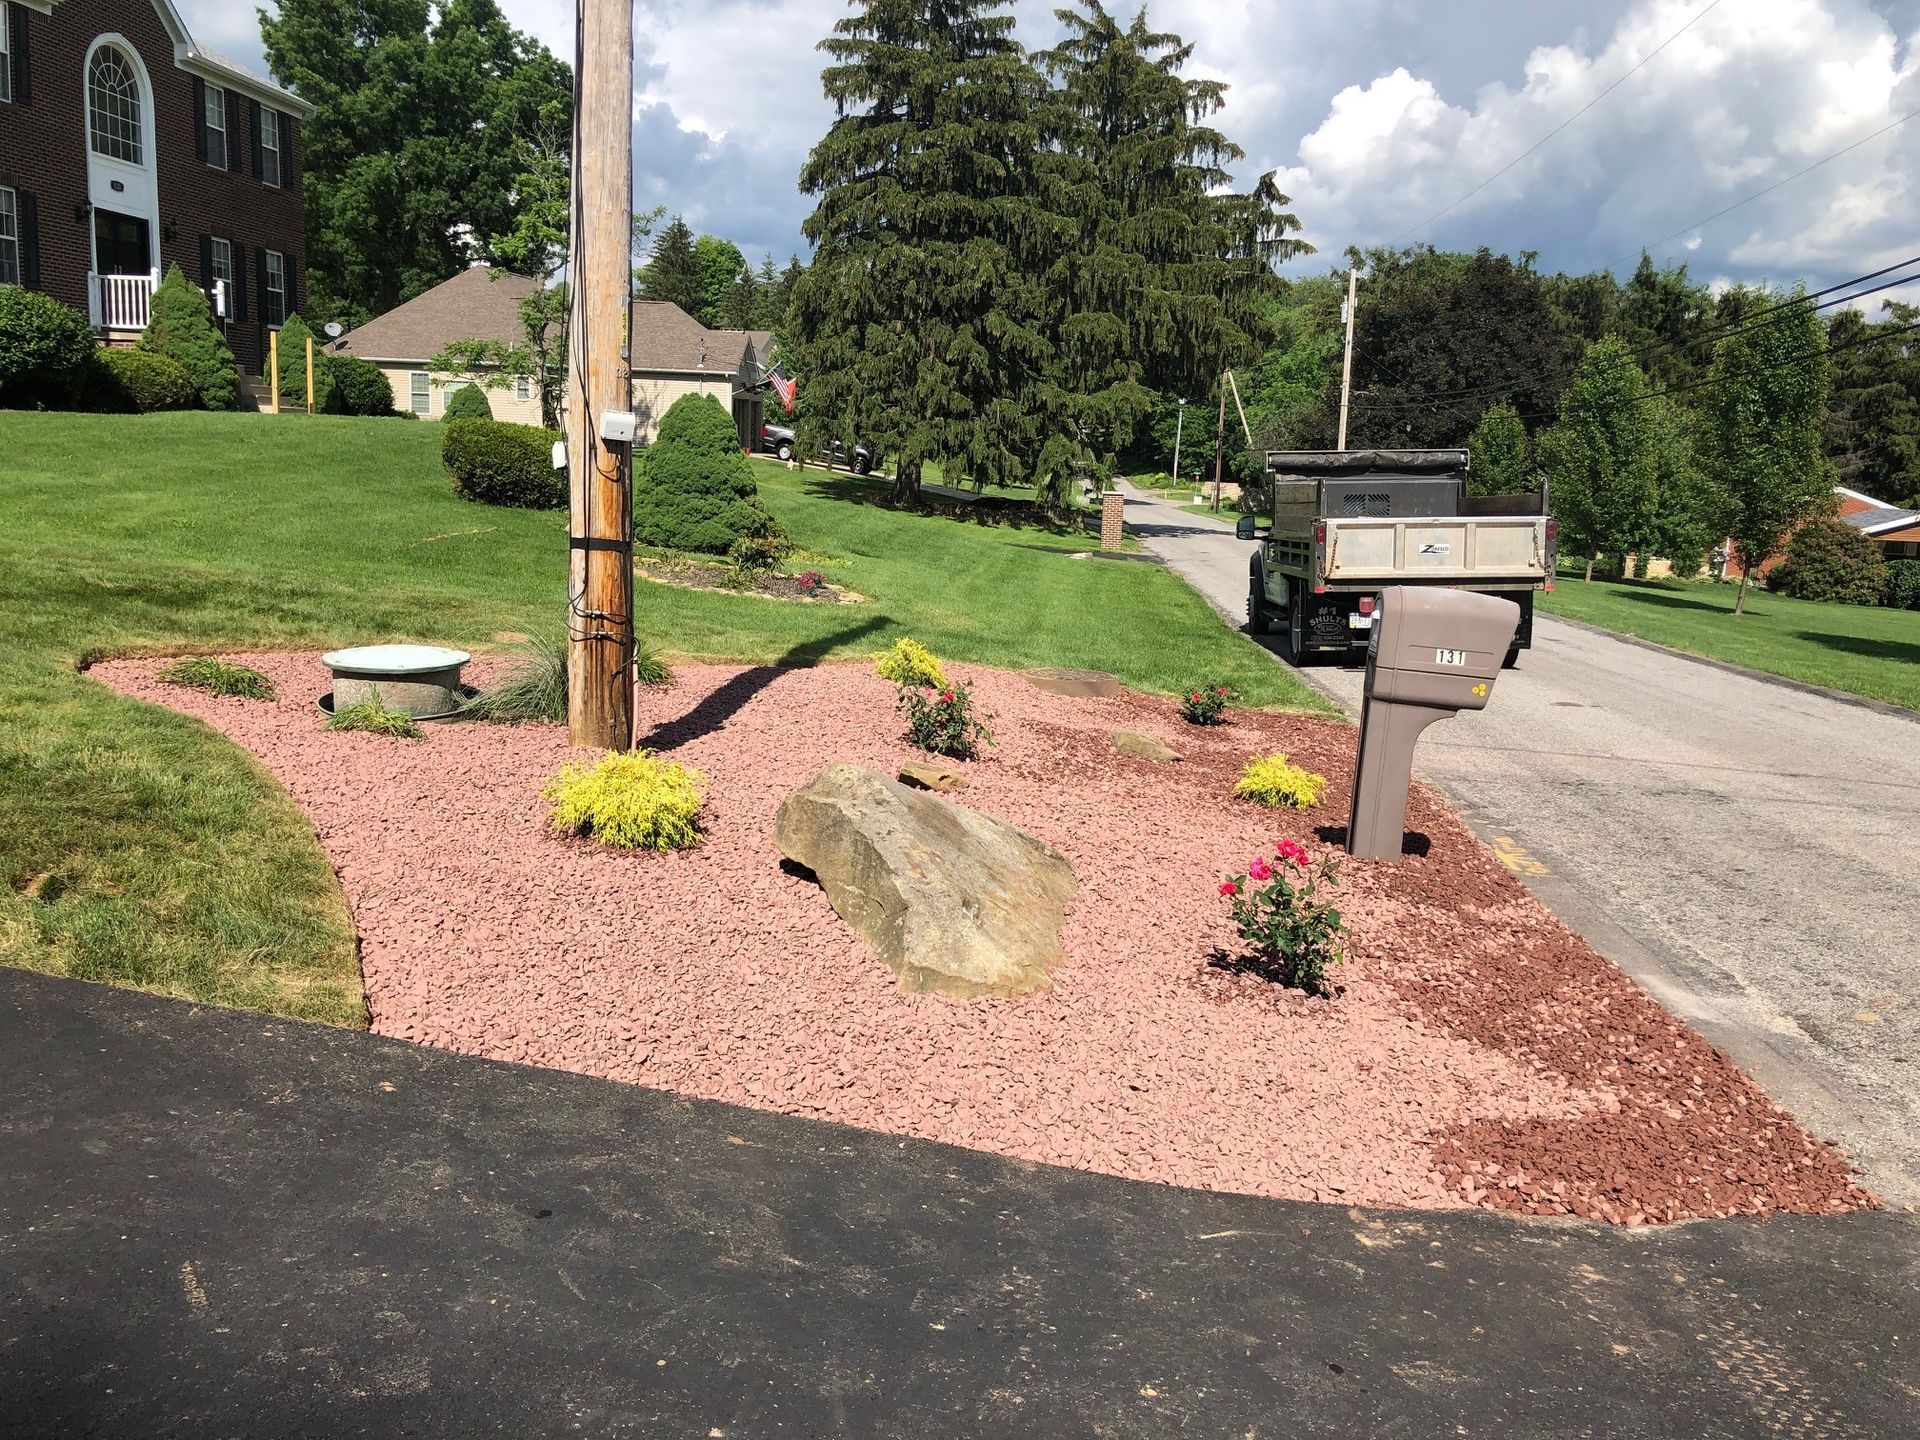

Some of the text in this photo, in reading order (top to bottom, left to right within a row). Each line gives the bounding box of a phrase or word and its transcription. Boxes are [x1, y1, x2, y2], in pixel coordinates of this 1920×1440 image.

[1318, 606, 1337, 615] #1
[1309, 615, 1347, 626] SHULTS
[1439, 650, 1463, 665] 131
